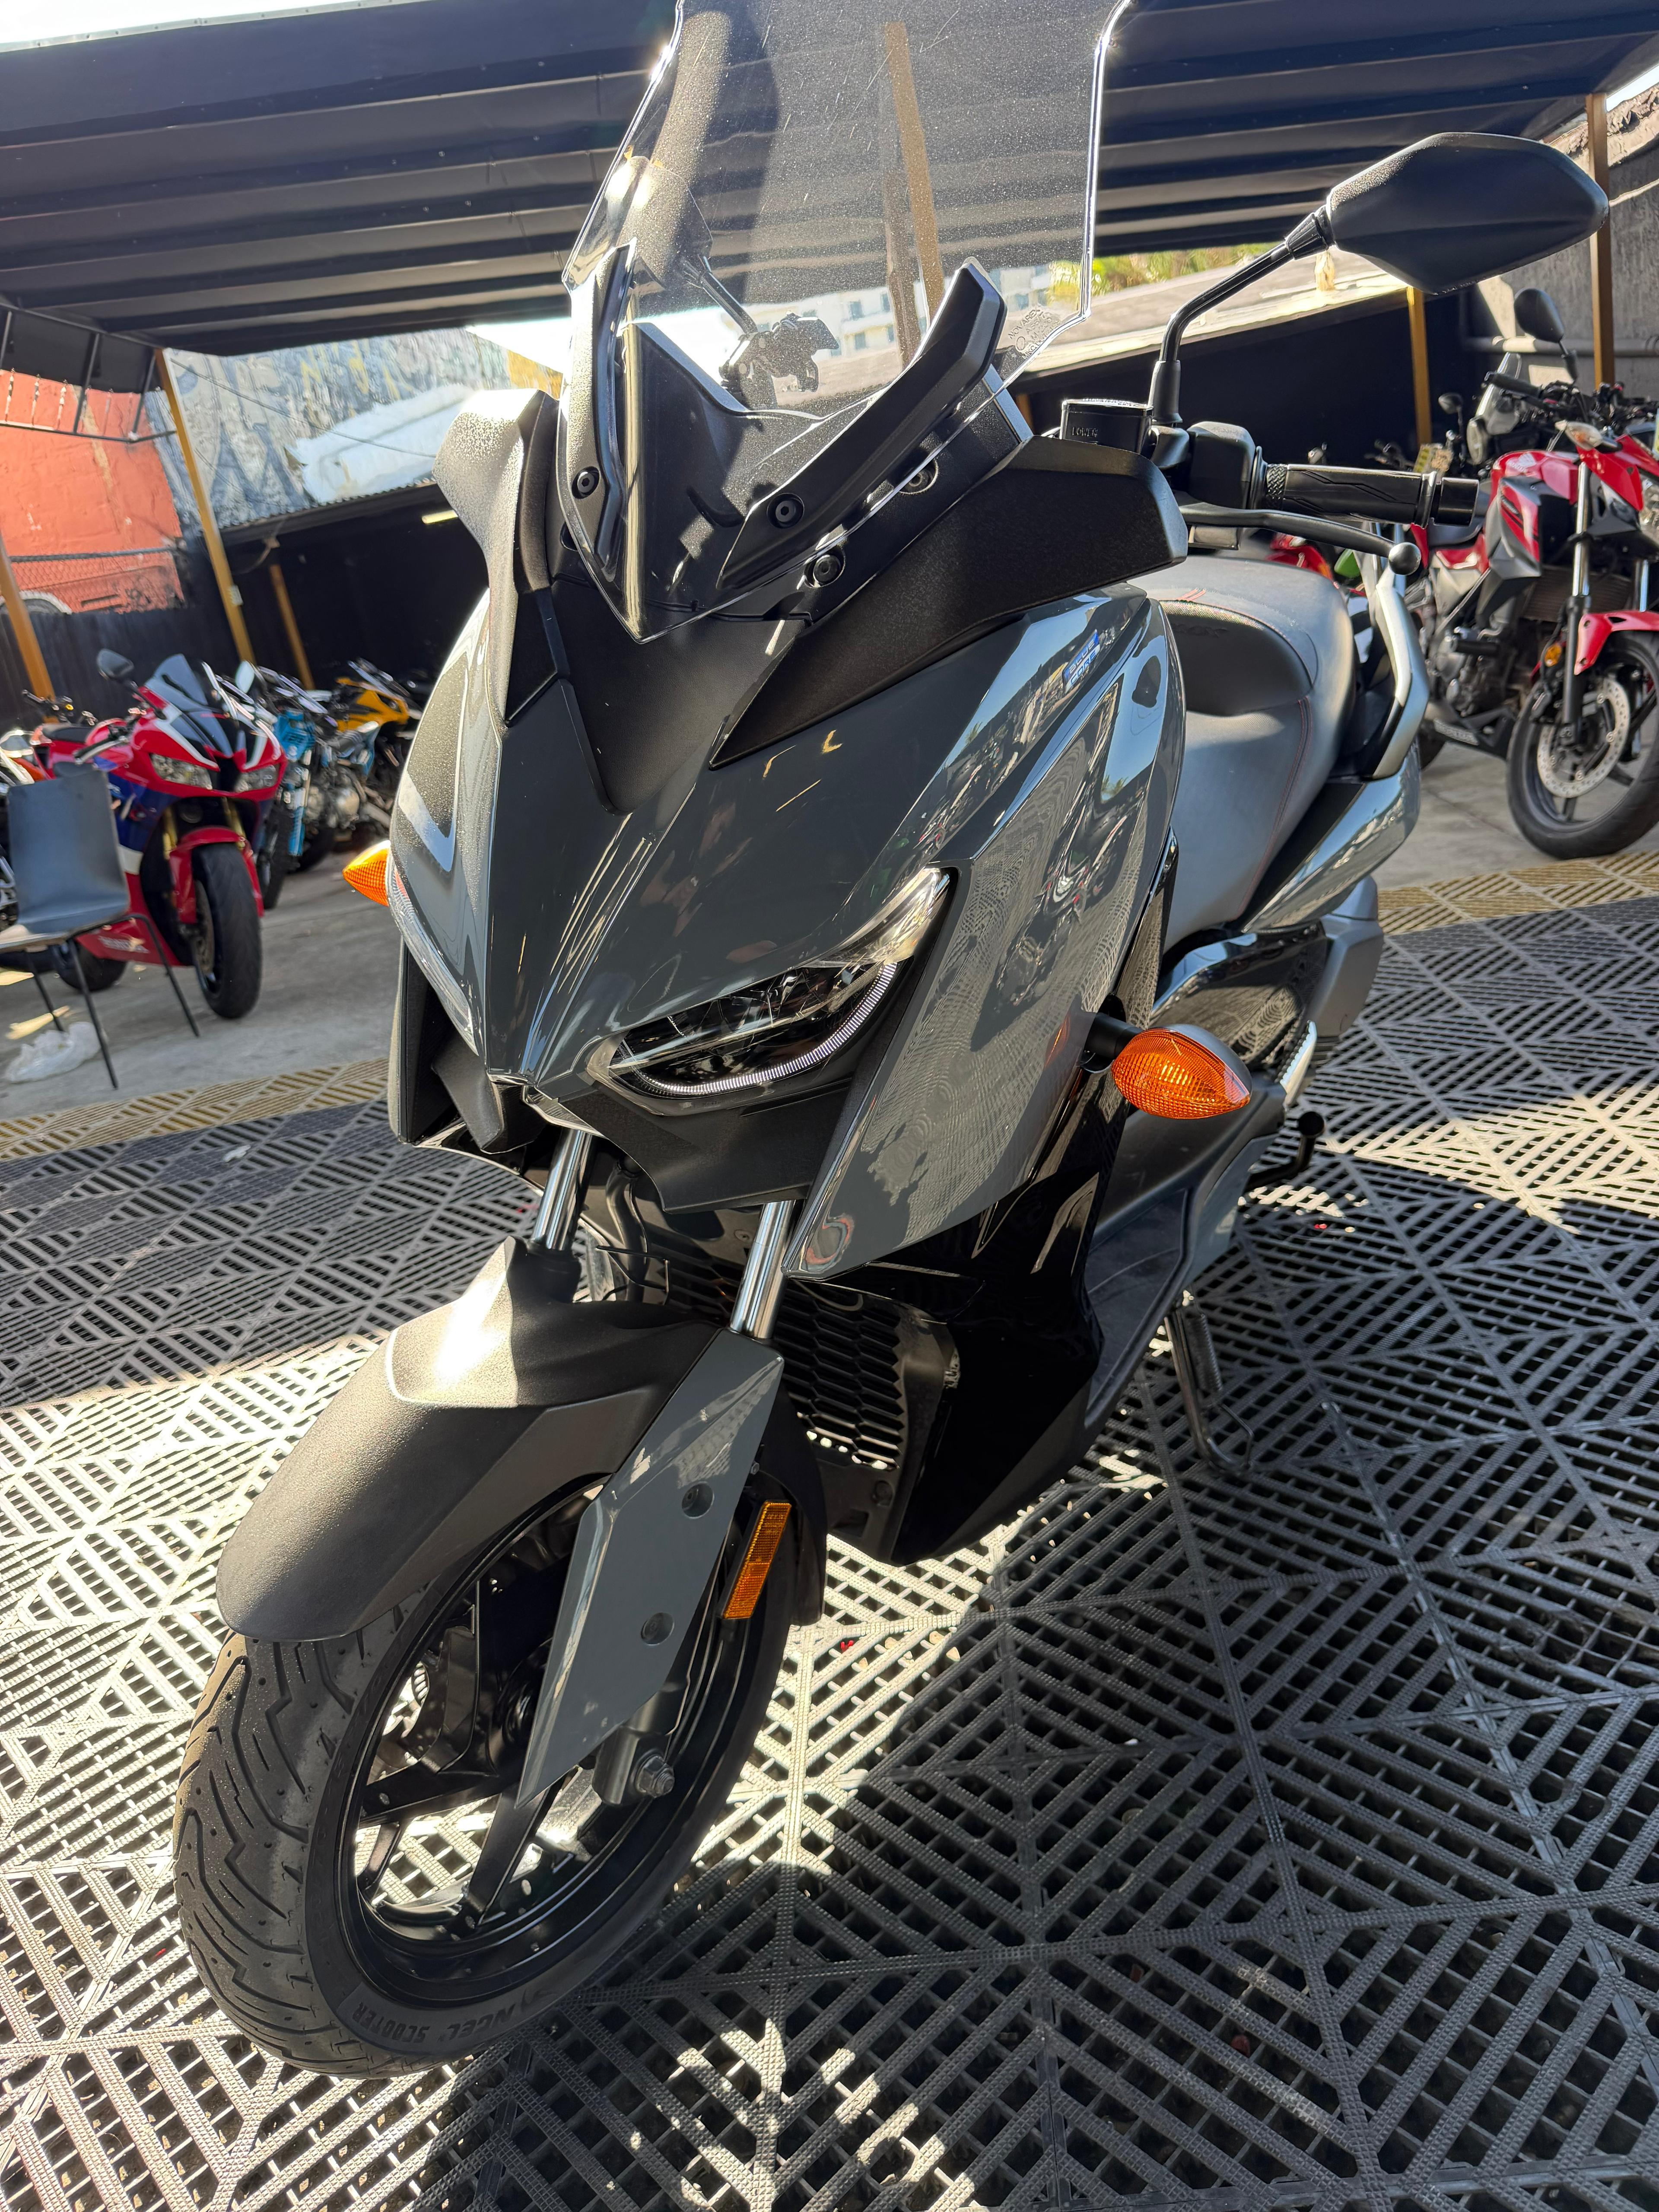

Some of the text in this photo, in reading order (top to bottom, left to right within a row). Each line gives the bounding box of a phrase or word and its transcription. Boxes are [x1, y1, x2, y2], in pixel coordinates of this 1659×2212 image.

[1008, 306, 1041, 339] NOVAREX
[1071, 426, 1098, 438] LOWER
[1069, 639, 1095, 674] BLUE
[1071, 650, 1096, 685] CORE
[353, 2002, 430, 2044] SCOOTER
